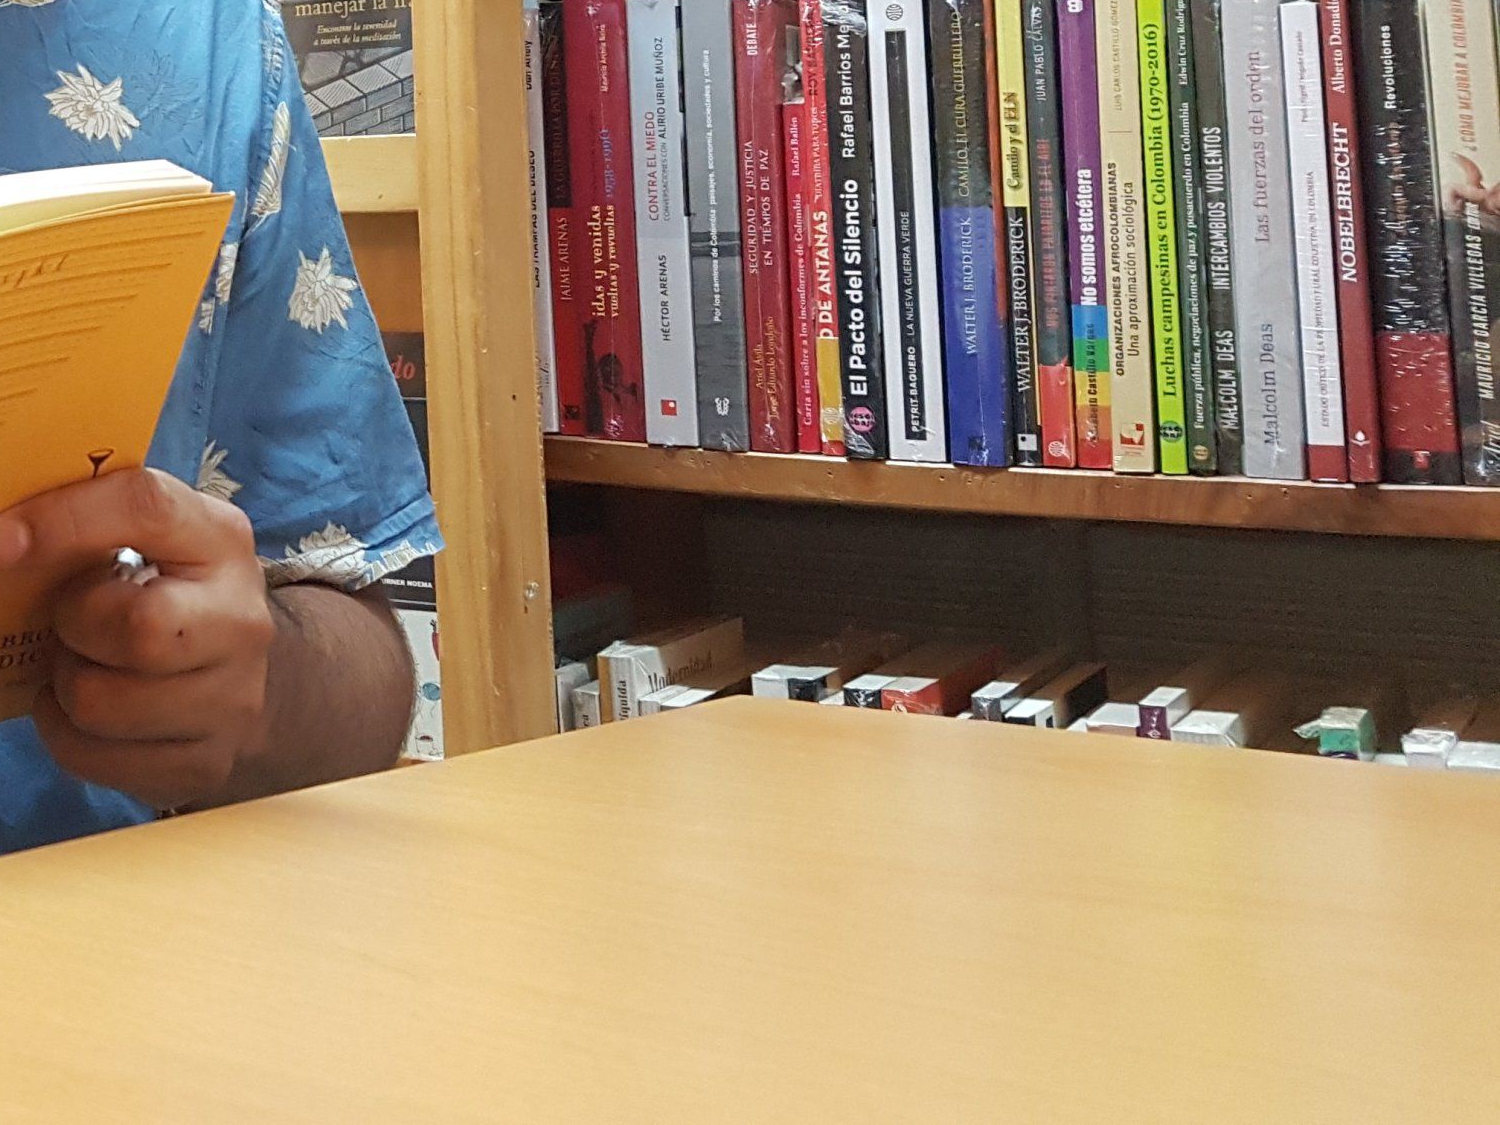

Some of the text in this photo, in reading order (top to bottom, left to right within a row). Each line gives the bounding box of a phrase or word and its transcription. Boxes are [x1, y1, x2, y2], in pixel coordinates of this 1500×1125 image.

[294, 0, 366, 19] manejar
[746, 22, 759, 57] DEBATE
[654, 36, 667, 139] ALIRIO URIBE MUÑOZ
[836, 52, 856, 158] Rafael Barrios
[1034, 42, 1047, 102] JUAN PABLO
[1112, 62, 1123, 112] LUIS CARLOS
[1177, 37, 1189, 87] Edwin Cruz
[1328, 50, 1346, 95] Alberto
[1380, 24, 1398, 111] Revoluciones
[790, 145, 802, 177] Rafael
[954, 94, 968, 133] CURA
[1245, 50, 1271, 245] Las fuerzas del orden
[644, 110, 660, 222] CONTRA EL MIEDO
[702, 49, 723, 323] Por los caminos de sociedades cultura
[743, 140, 759, 275] SEGURIDAD Y JUSTICIA
[757, 148, 774, 267] EN TIEMPOS DE PAZ
[1146, 22, 1180, 398] Luchas campesinas en Colombia (1970-2016)
[1202, 125, 1230, 291] INTERCAMBIOS VIOLENTOS
[1331, 122, 1359, 283] NOBELBRECHT
[555, 216, 573, 302] JAIME ARENAS
[586, 205, 606, 317] idas venidas
[792, 192, 808, 338] los inconformes de Colombia
[813, 210, 832, 296] ANTANAS
[839, 178, 863, 265] Silencio
[1076, 168, 1098, 307] No somos etcétera
[1107, 161, 1126, 377] ORGANIZACIONES AFROCOLOMBIANAS
[1122, 181, 1143, 357] Una aproximación sociológica
[1179, 102, 1205, 353] negociaciones de paz en Colombia
[658, 254, 672, 342] HÉCTOR ARENAS
[817, 299, 834, 325] DE
[843, 270, 864, 305] del
[900, 210, 921, 433] PETRIT BAQUERO LA NUEVA GUERRA VERDE
[959, 216, 979, 355] WALTER BRODERICK
[1009, 216, 1033, 393] WALTER J. BRODERICK
[1464, 234, 1496, 400] MAURICIO GARCÍA VILLEGAS
[765, 356, 778, 394] Eduardo
[847, 311, 867, 372] Pacto
[850, 375, 869, 396] El
[1214, 329, 1239, 431] MALCOLM DEAS
[1258, 322, 1279, 448] Malcolm Deas
[1320, 397, 1330, 428] ESTADO
[647, 650, 714, 693] Modernidad
